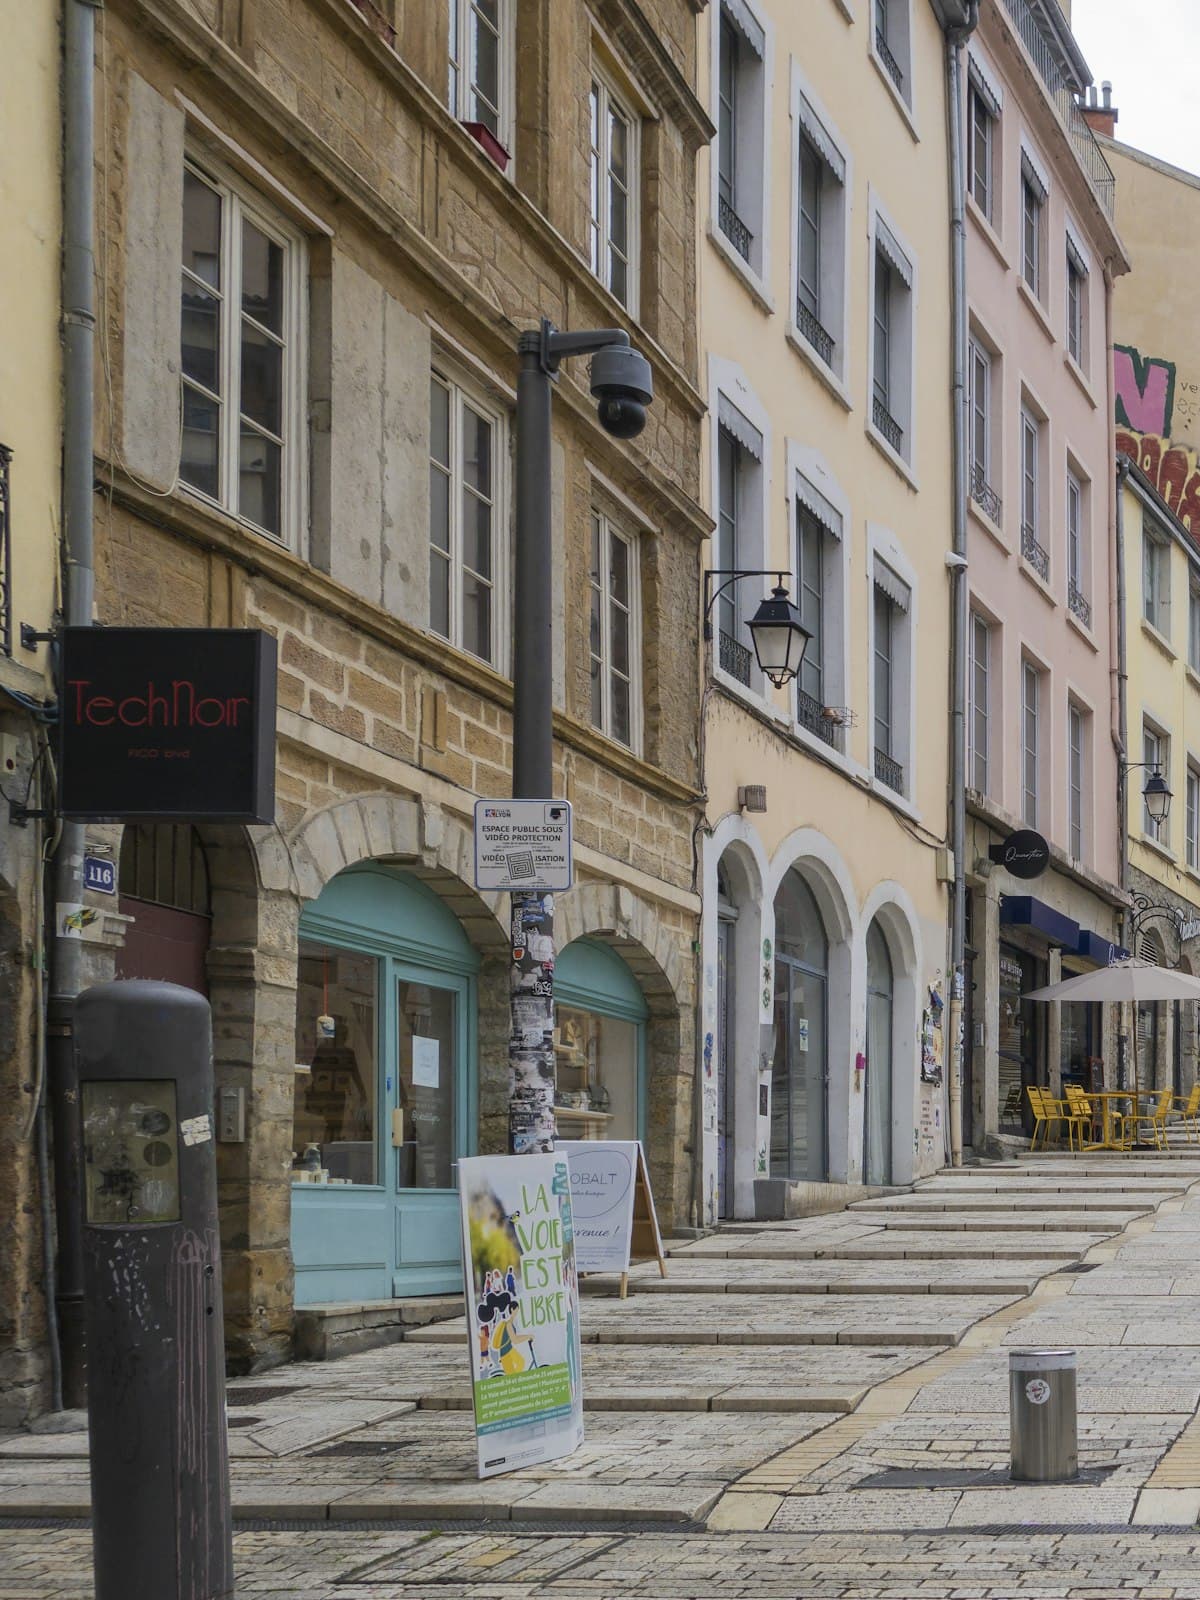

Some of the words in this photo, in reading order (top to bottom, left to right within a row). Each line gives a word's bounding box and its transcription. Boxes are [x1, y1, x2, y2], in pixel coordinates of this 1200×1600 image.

[68, 680, 249, 726] TechNoir
[482, 825, 510, 833] ESPACE
[485, 833, 510, 841] VIDÉO
[482, 853, 506, 862] VIDÉO
[89, 865, 111, 884] 116
[570, 1173, 617, 1185] OBALT
[522, 1184, 549, 1215] LA
[517, 1219, 562, 1252] VOIE
[523, 1255, 562, 1290] EST
[518, 1291, 566, 1329] LIBRE
